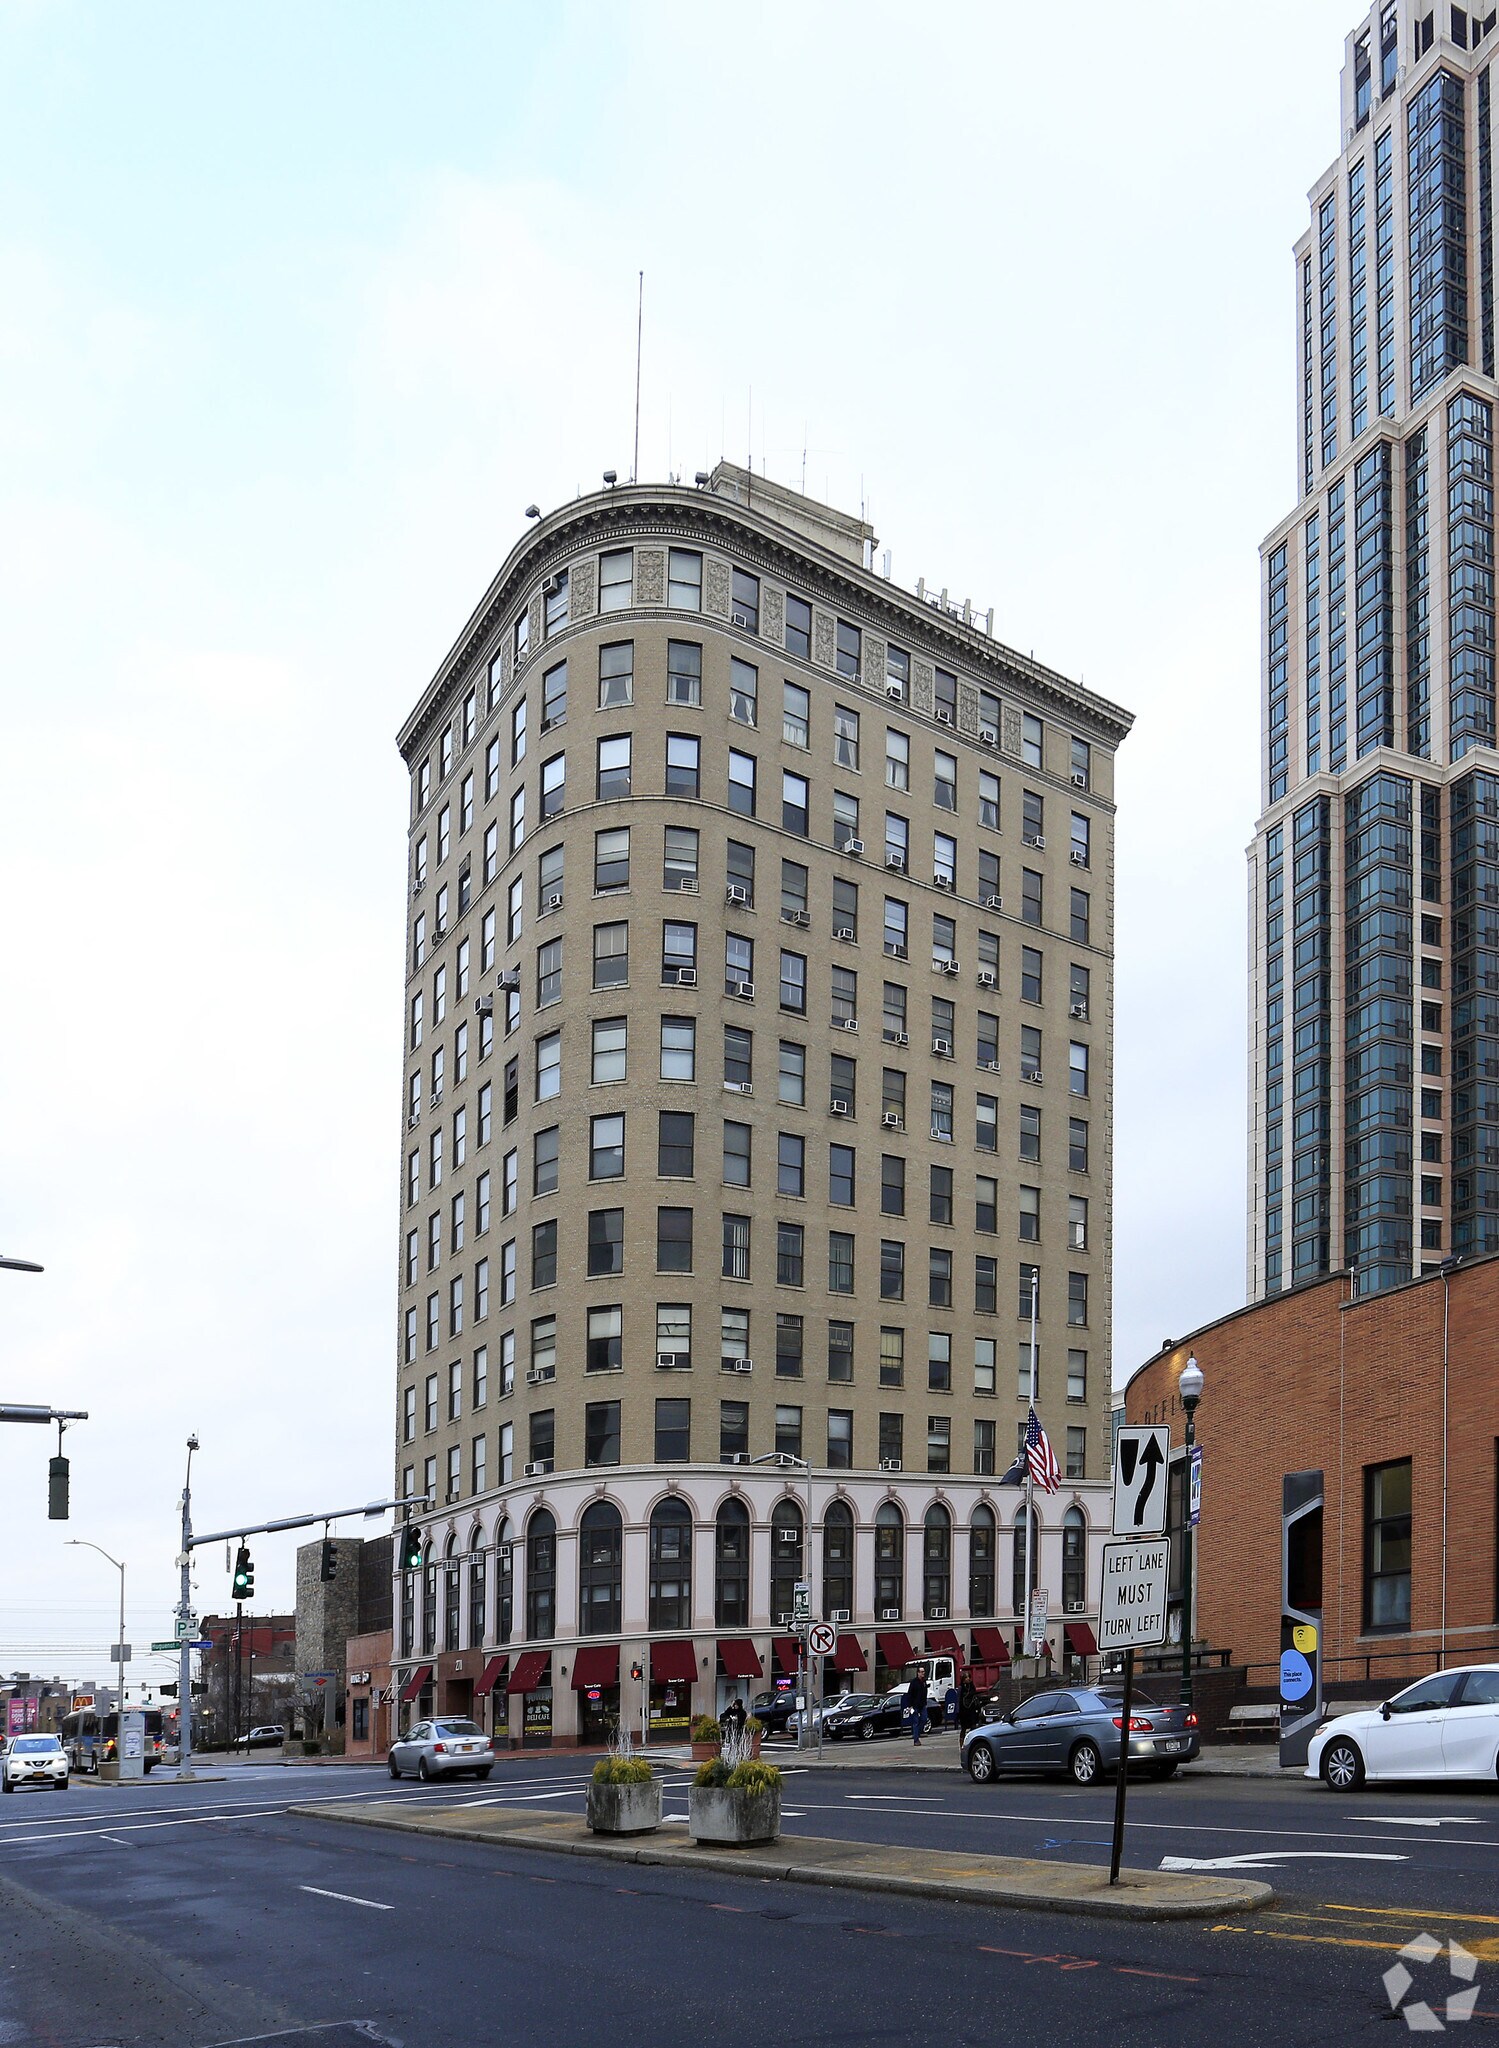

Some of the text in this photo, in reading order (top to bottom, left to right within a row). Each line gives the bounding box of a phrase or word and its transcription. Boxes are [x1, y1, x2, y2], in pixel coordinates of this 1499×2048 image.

[1109, 1553, 1164, 1574] LEFT LANE
[1117, 1583, 1153, 1606] MUST
[1105, 1614, 1161, 1636] TURN LEFT
